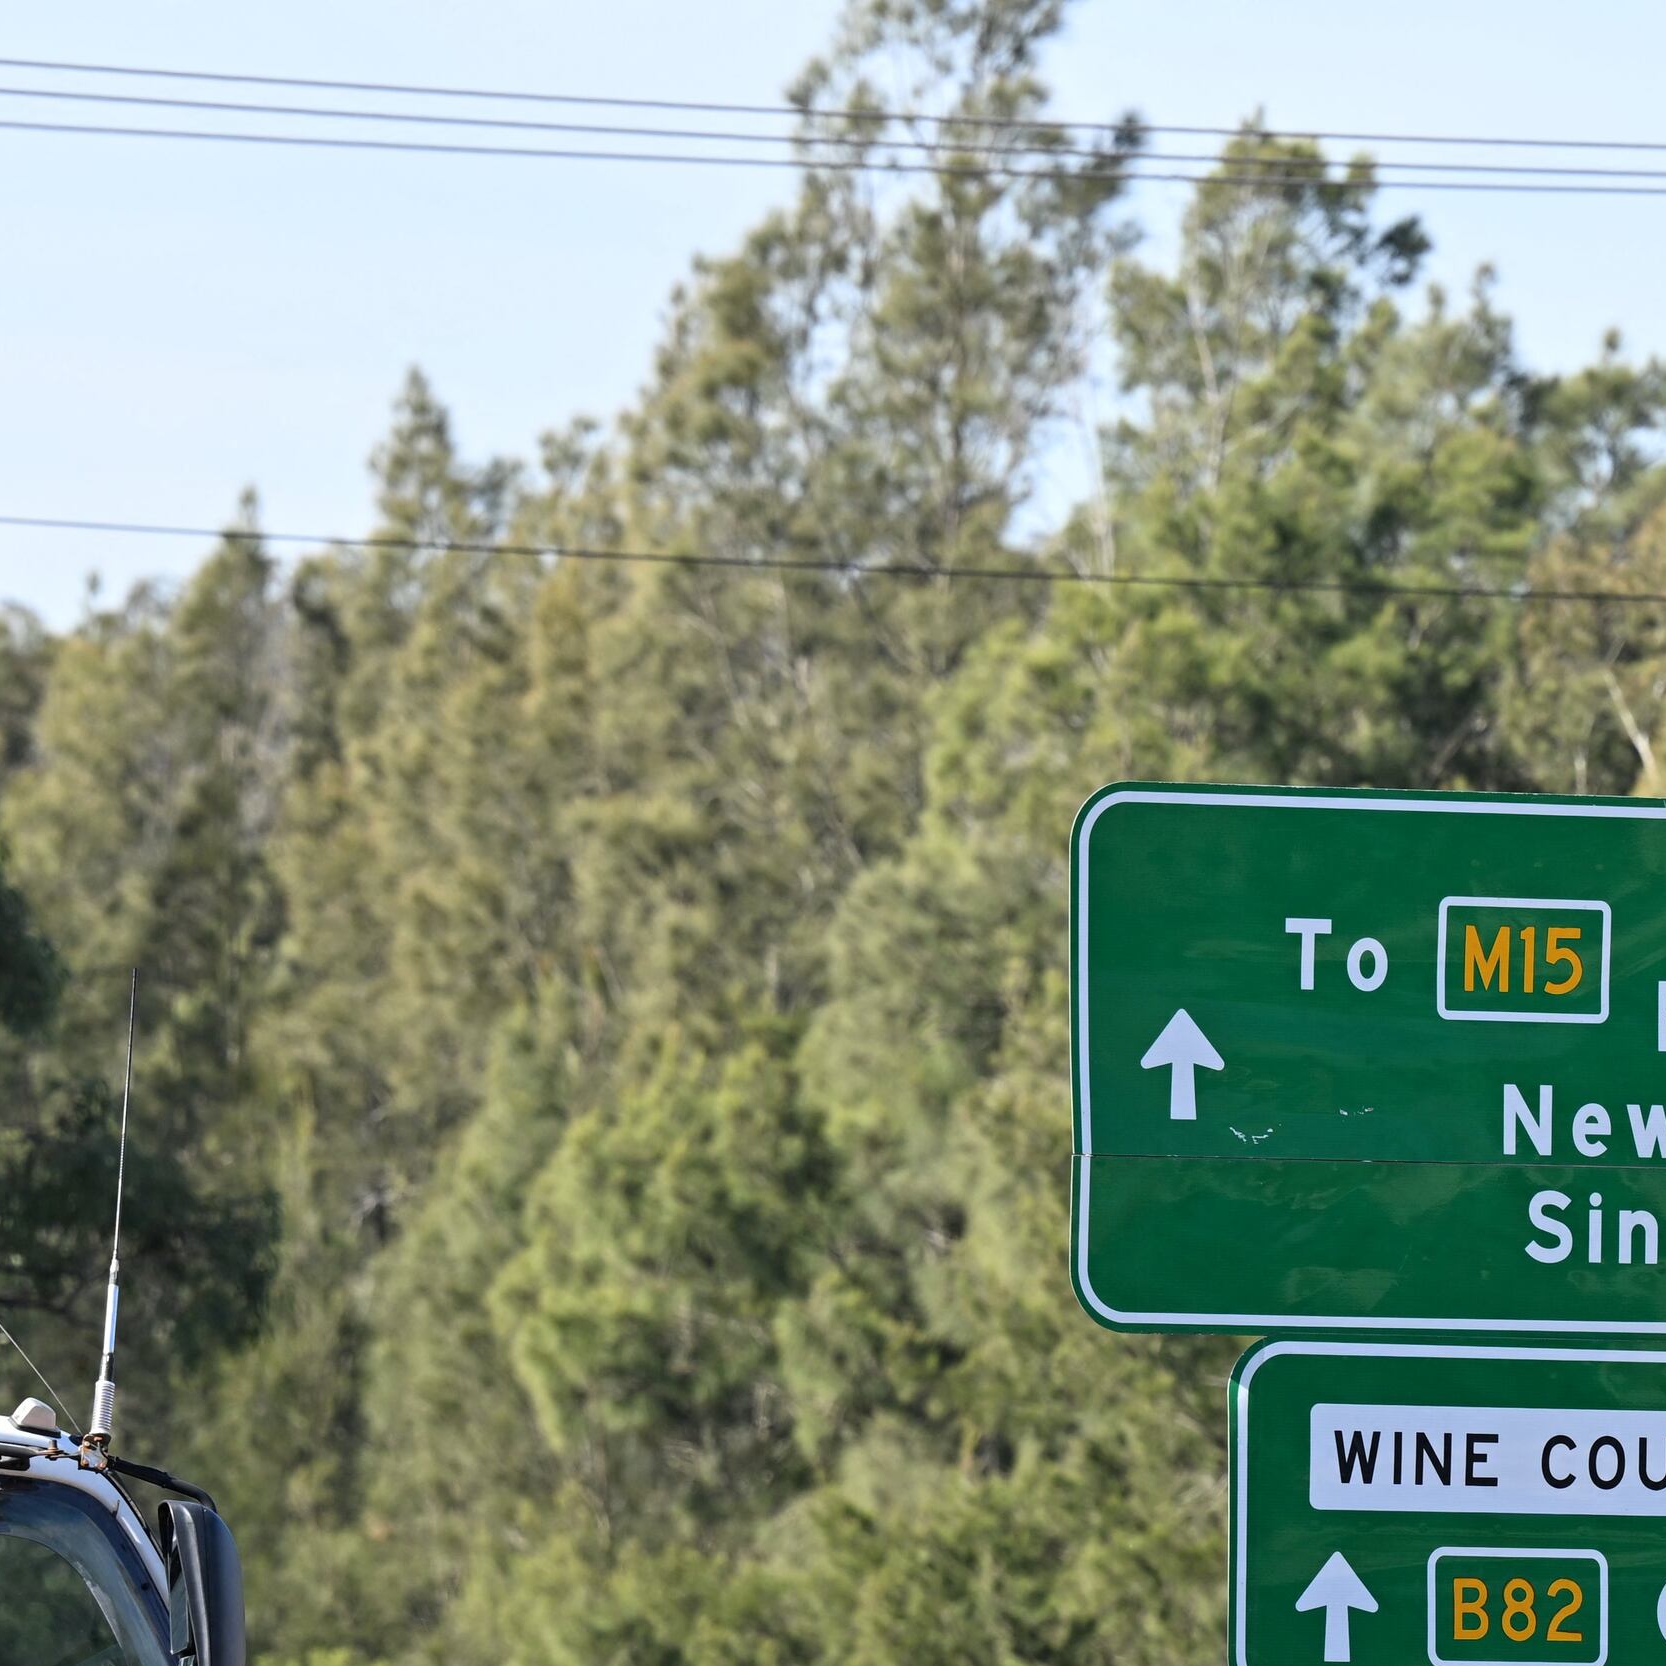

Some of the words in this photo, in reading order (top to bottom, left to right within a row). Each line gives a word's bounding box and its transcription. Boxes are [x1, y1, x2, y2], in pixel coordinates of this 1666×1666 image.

[1285, 917, 1389, 993] To
[1464, 925, 1584, 996] M15
[1333, 1430, 1500, 1488] WINE
[1452, 1577, 1584, 1642] B82
